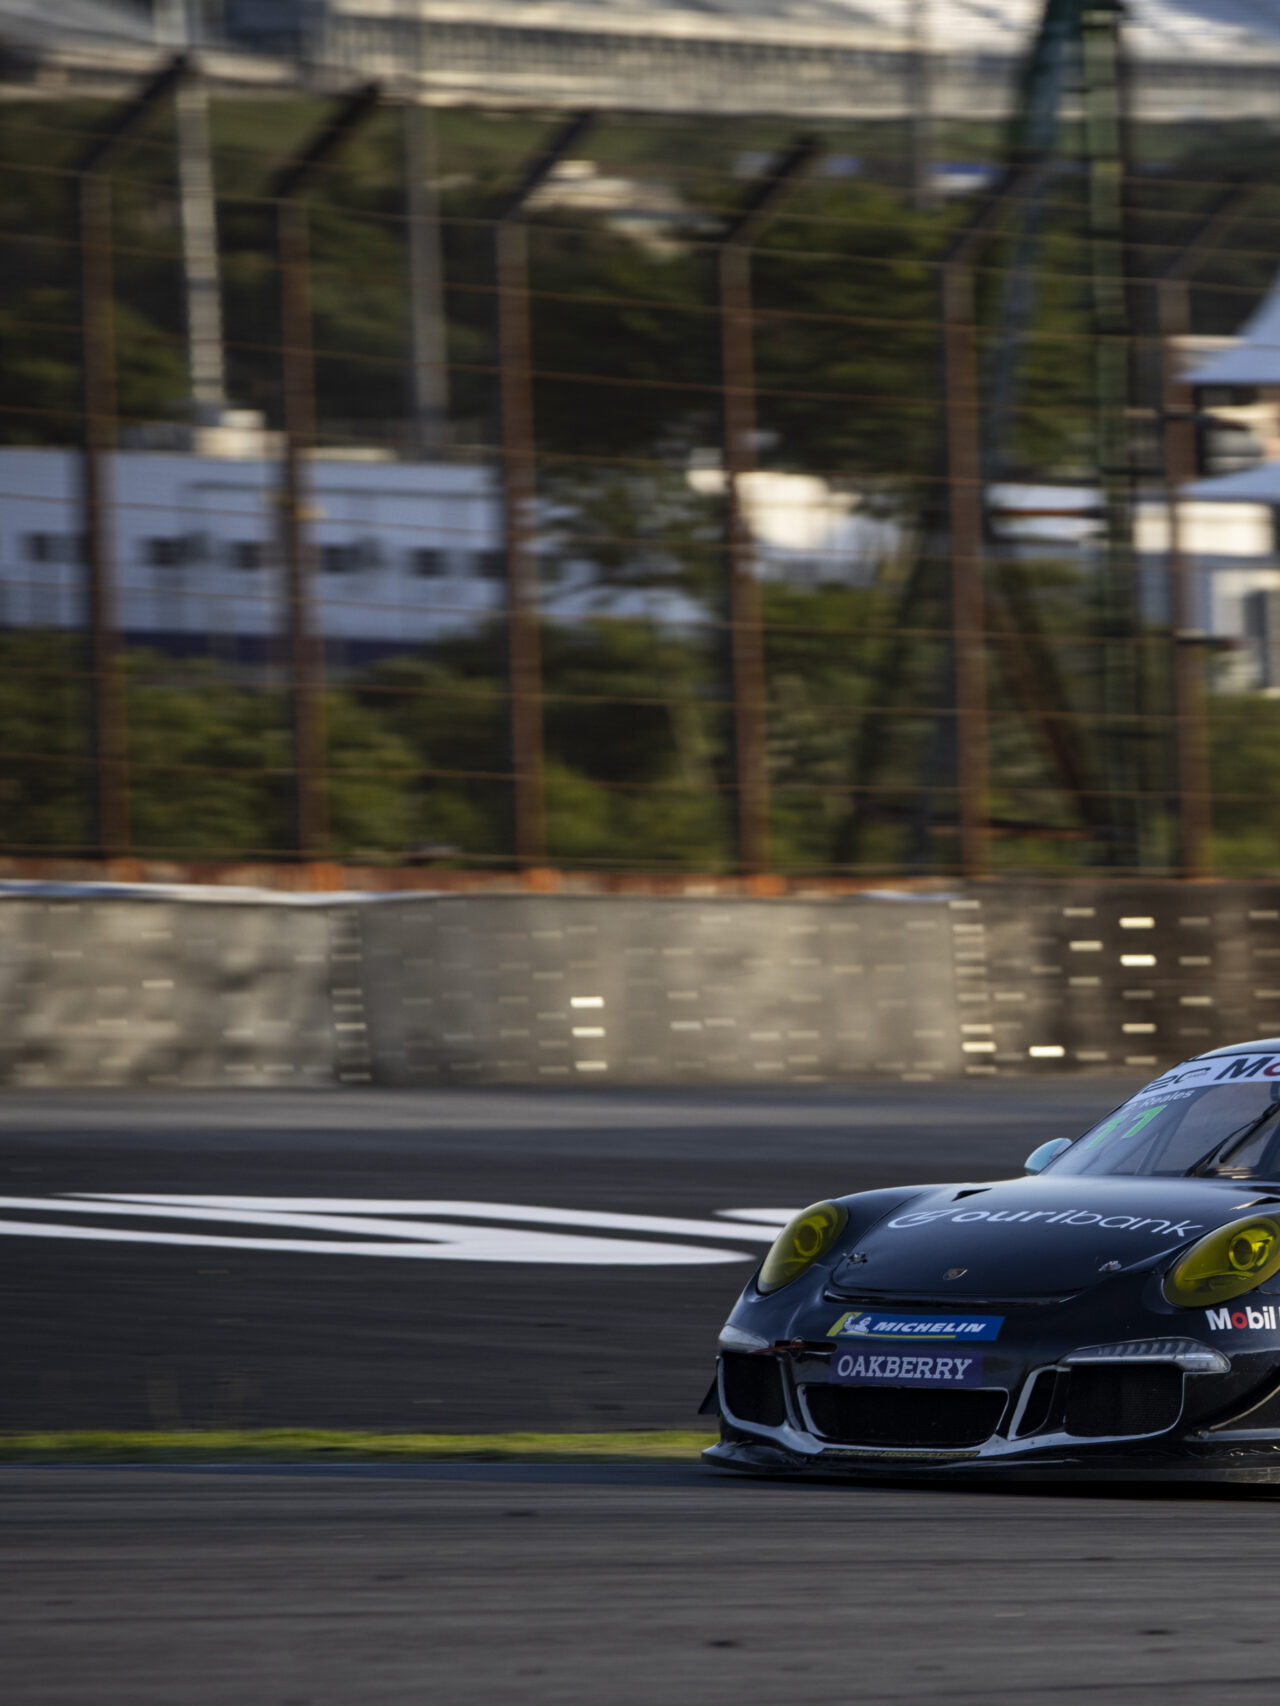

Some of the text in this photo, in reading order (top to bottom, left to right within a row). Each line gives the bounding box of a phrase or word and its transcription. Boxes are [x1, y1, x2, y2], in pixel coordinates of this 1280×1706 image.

[951, 1208, 1203, 1238] ouribank
[872, 1321, 987, 1334] MICHELIN
[1204, 1305, 1277, 1331] Mobil
[837, 1354, 973, 1381] OAKBERRY
